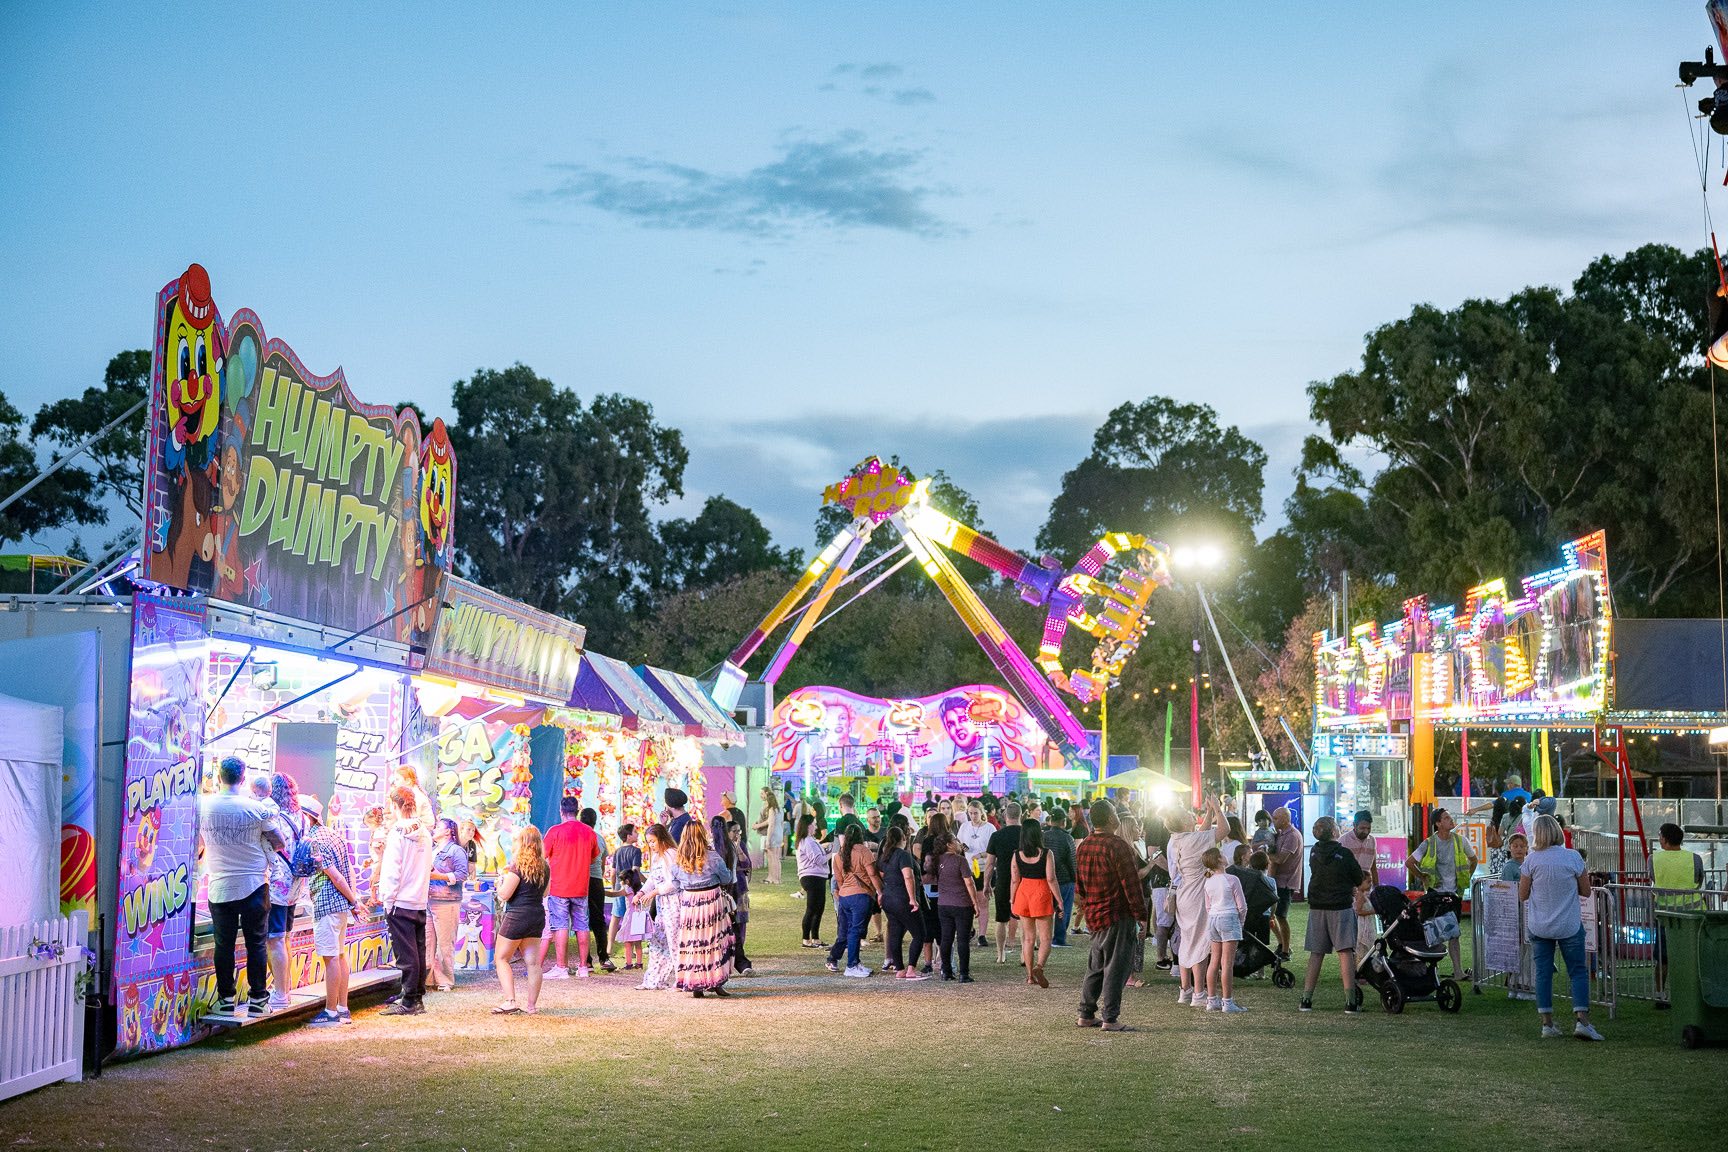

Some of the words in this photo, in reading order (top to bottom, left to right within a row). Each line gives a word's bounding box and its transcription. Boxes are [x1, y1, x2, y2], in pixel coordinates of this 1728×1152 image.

[252, 367, 405, 504] HUMPTY
[822, 466, 899, 505] HARD
[238, 455, 397, 580] DUMPTY
[449, 601, 524, 666] HUMPTY
[438, 723, 495, 766] GA
[127, 757, 197, 821] PLAYER
[437, 767, 505, 810] ZES
[1376, 859, 1405, 869] RIOUS
[124, 863, 189, 936] WINS
[308, 931, 396, 987] DMPTY
